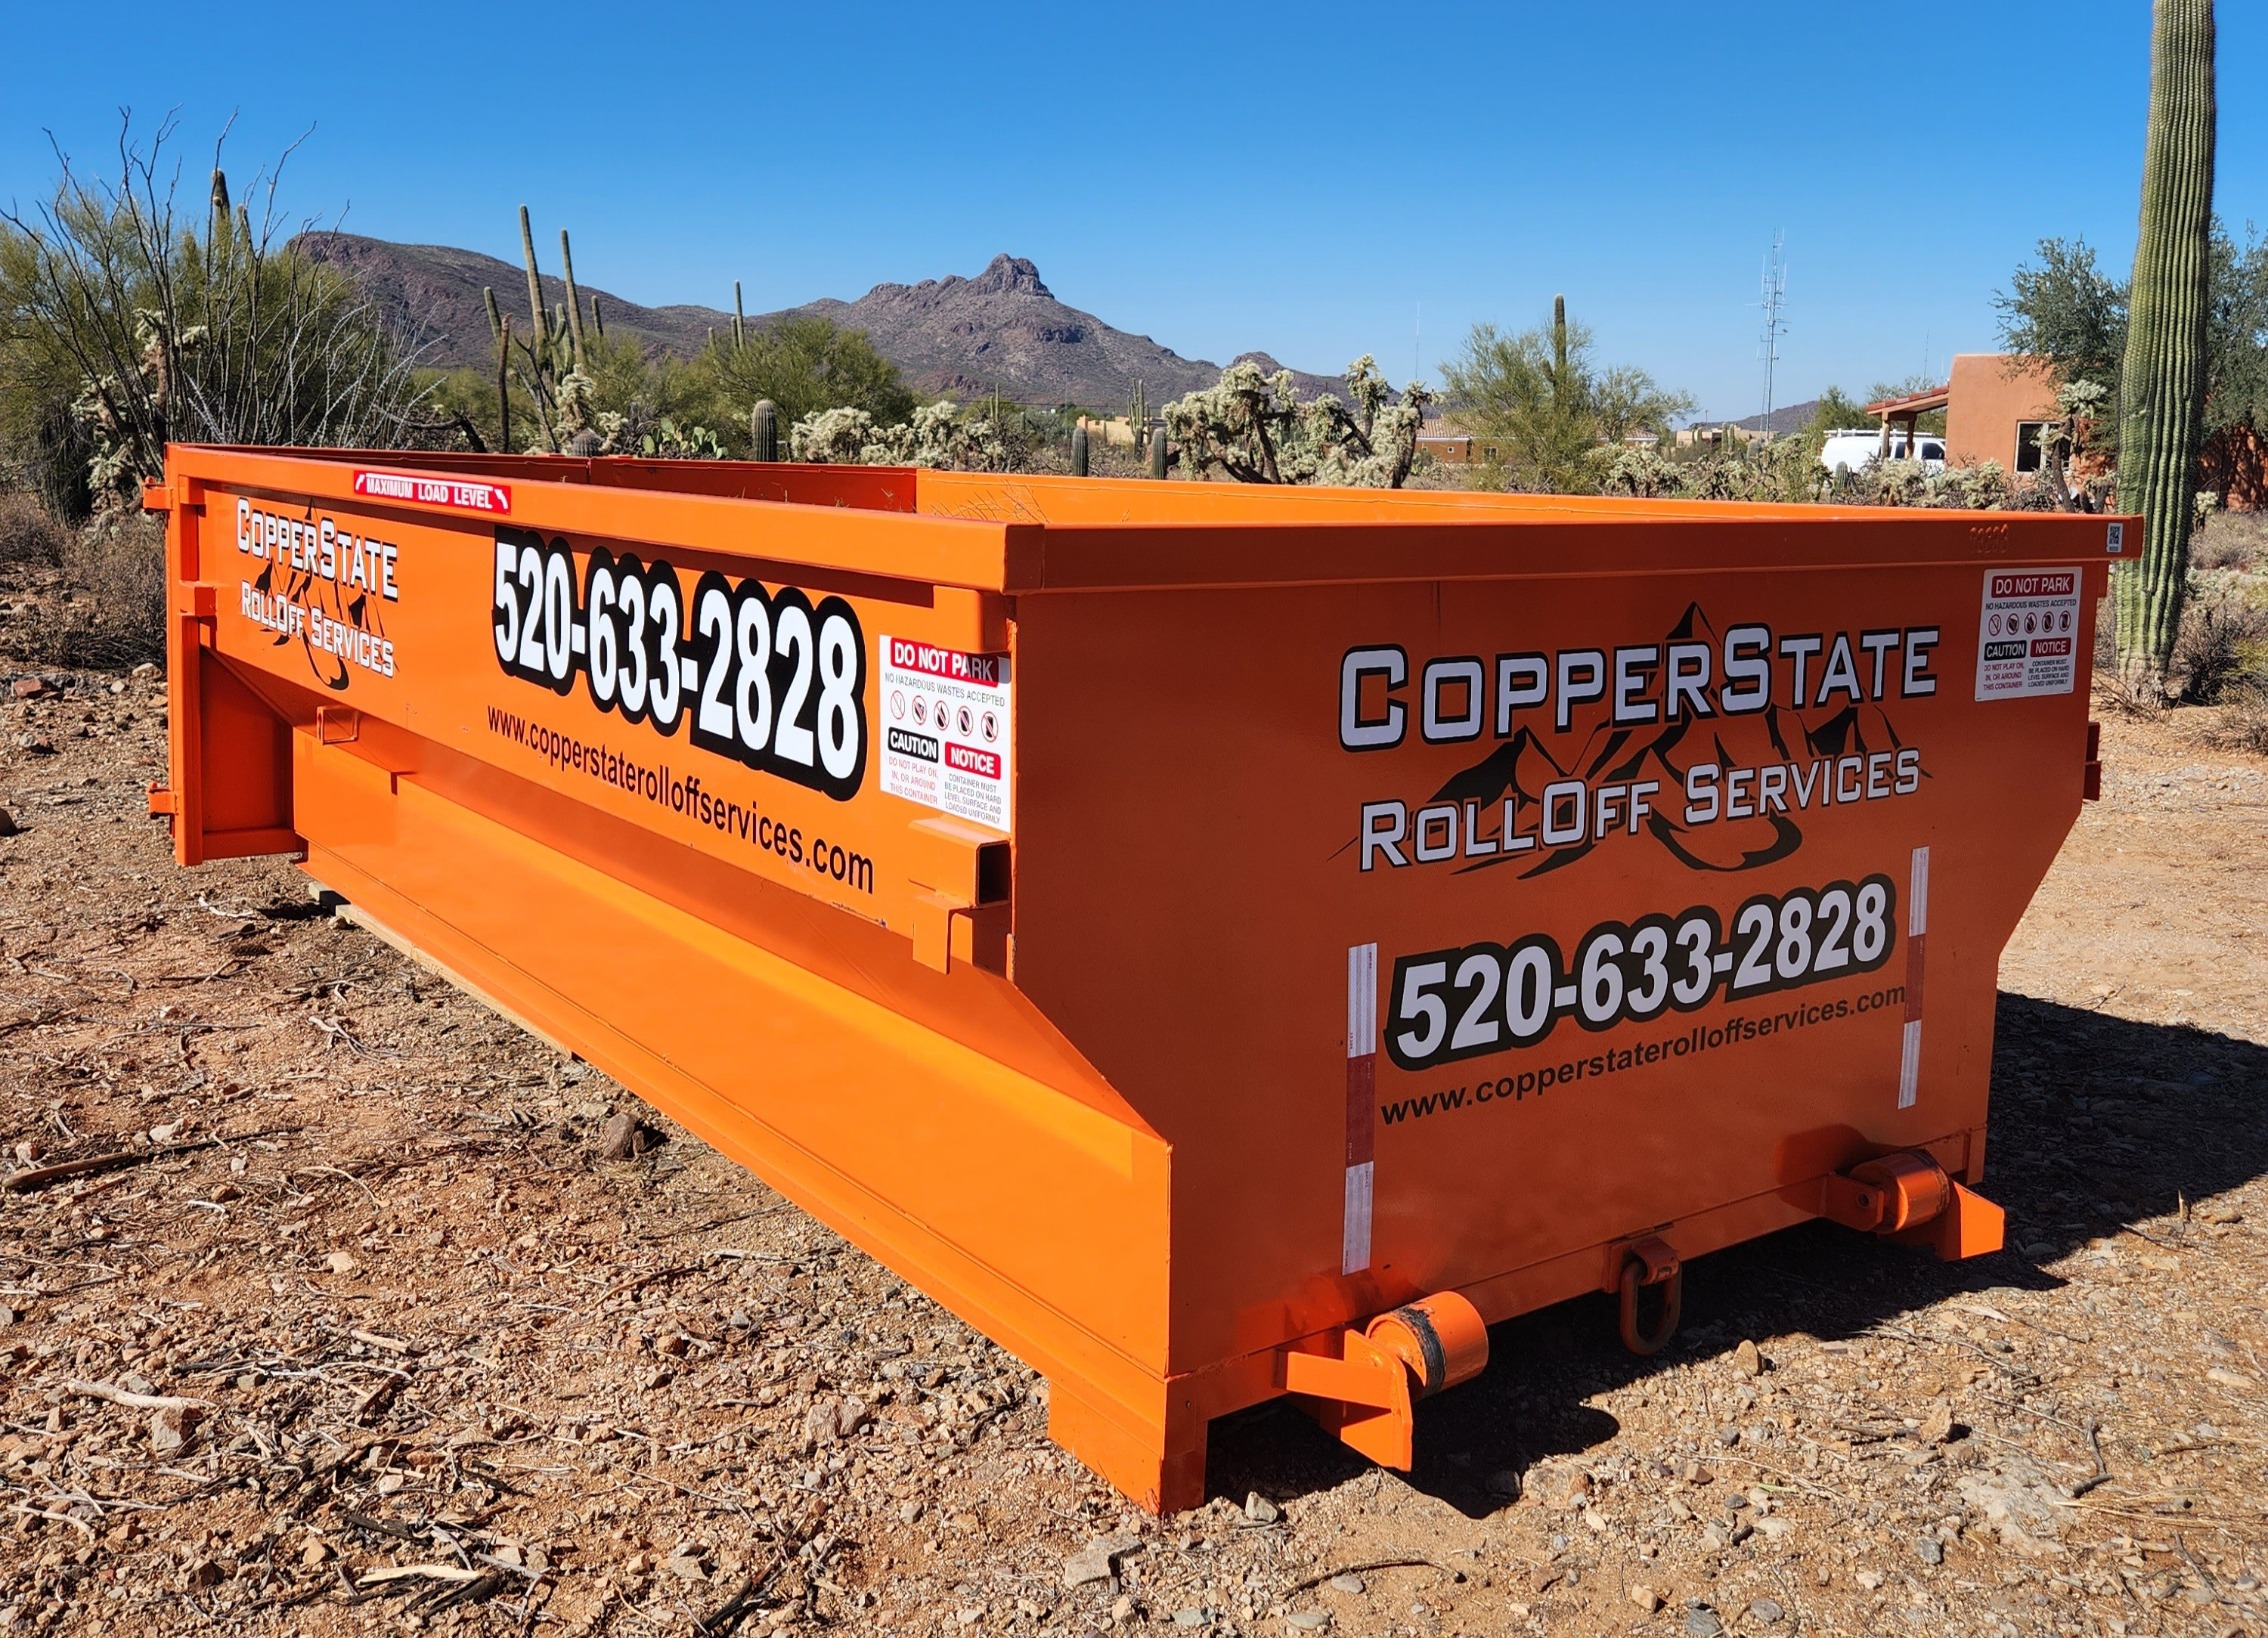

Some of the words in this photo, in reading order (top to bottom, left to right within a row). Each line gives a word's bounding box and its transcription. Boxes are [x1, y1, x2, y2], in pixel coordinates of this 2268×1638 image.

[366, 477, 413, 499] MAXIMUM
[418, 484, 448, 503] LOAD
[454, 487, 493, 508] LEVEL
[1996, 579, 2012, 594] DO
[2015, 577, 2039, 593] NOT
[2041, 577, 2071, 592] PARK
[1994, 601, 2027, 610] HAZARDOUS
[2028, 600, 2050, 608] WASTES
[1986, 643, 2025, 658] CAUTION
[2035, 641, 2067, 654] NOTICE
[495, 542, 859, 779] 520-633-2828
[894, 643, 915, 666] DO
[919, 647, 948, 673] NOT
[952, 653, 993, 682] PARK
[885, 672, 894, 683] NO
[895, 673, 935, 692] HAZARDOUS
[937, 683, 965, 698] WASTES
[967, 690, 1005, 707] ACCEPTED
[1995, 681, 2022, 690] CONTAINER
[891, 731, 937, 760] CAUTION
[888, 756, 897, 766] DO
[899, 759, 910, 770] NOT
[912, 763, 927, 774] PLAY
[928, 767, 938, 779] ON,
[951, 747, 995, 775] NOTICE
[890, 782, 903, 794] THIS
[904, 787, 937, 805] CONTAINER
[900, 773, 909, 783] OR
[911, 776, 936, 791] AROUND
[945, 782, 952, 791] BE
[953, 784, 974, 797] PLACED
[976, 791, 984, 800] ON
[986, 793, 1001, 805] HARD
[949, 773, 980, 789] CONTAINER
[981, 782, 996, 794] MUST
[487, 705, 874, 895] www.copperstaterolloffservices.com
[945, 791, 961, 802] LEVEL
[962, 797, 988, 811] SURFACE
[990, 804, 1001, 815] AND
[946, 801, 967, 814] LOADED
[968, 808, 1000, 824] UNIFORMLY
[1396, 882, 1885, 1058] 520-633-2828
[1381, 986, 1905, 1125] www.copperstaterolloffservices.com
